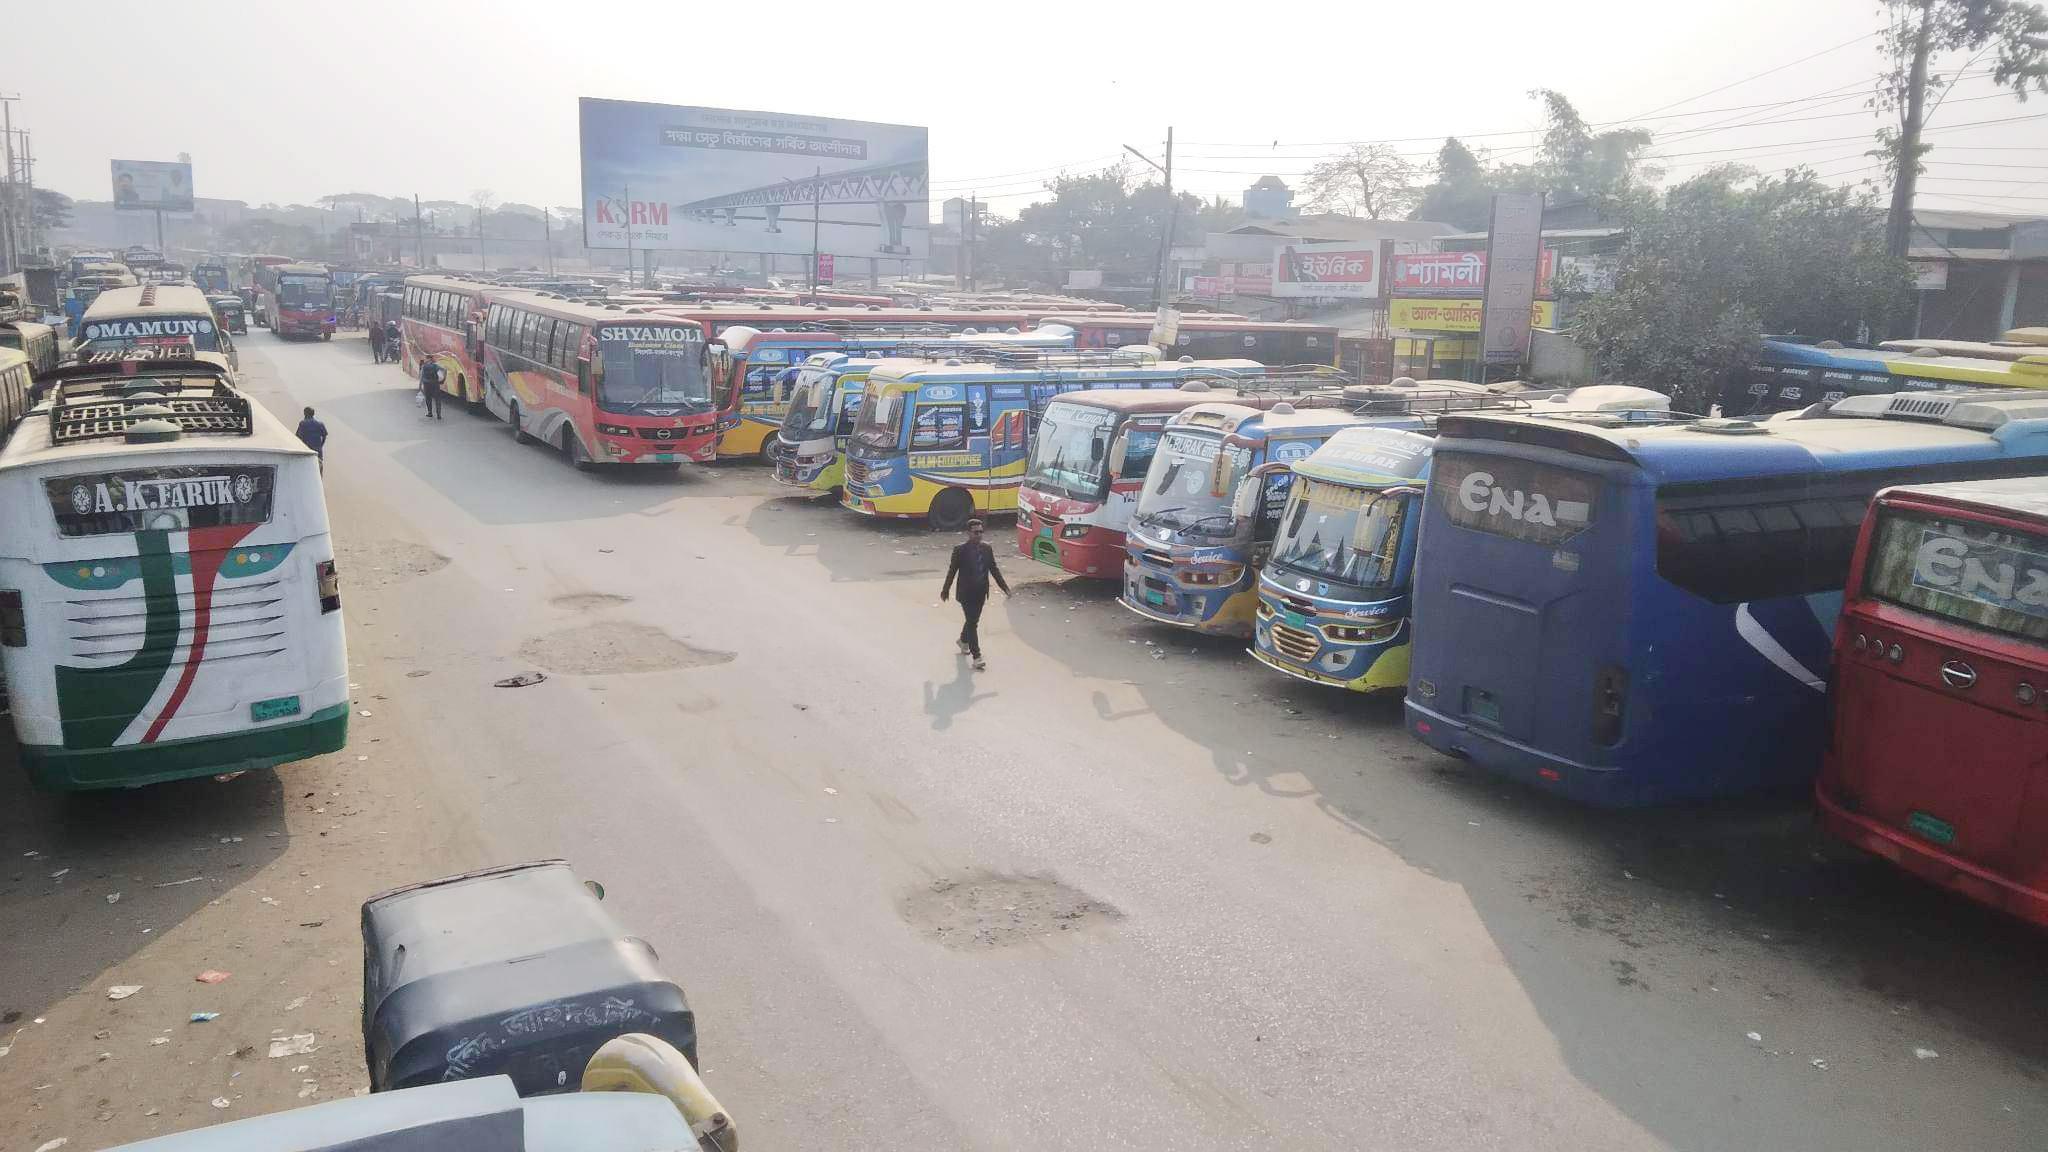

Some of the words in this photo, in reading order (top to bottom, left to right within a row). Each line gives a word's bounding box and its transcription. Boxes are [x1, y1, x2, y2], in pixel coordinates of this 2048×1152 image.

[665, 129, 692, 142] পদ্মা
[695, 132, 720, 147] সেতু
[723, 131, 771, 147] নির্মাণের
[809, 139, 862, 156] অংশীদার
[1302, 256, 1365, 281] ইউনিক
[1407, 252, 1485, 285] শ্যামলী
[98, 320, 199, 338] MAMUN
[600, 327, 706, 343] SHYAMOLI
[1174, 436, 1205, 456] BURAK
